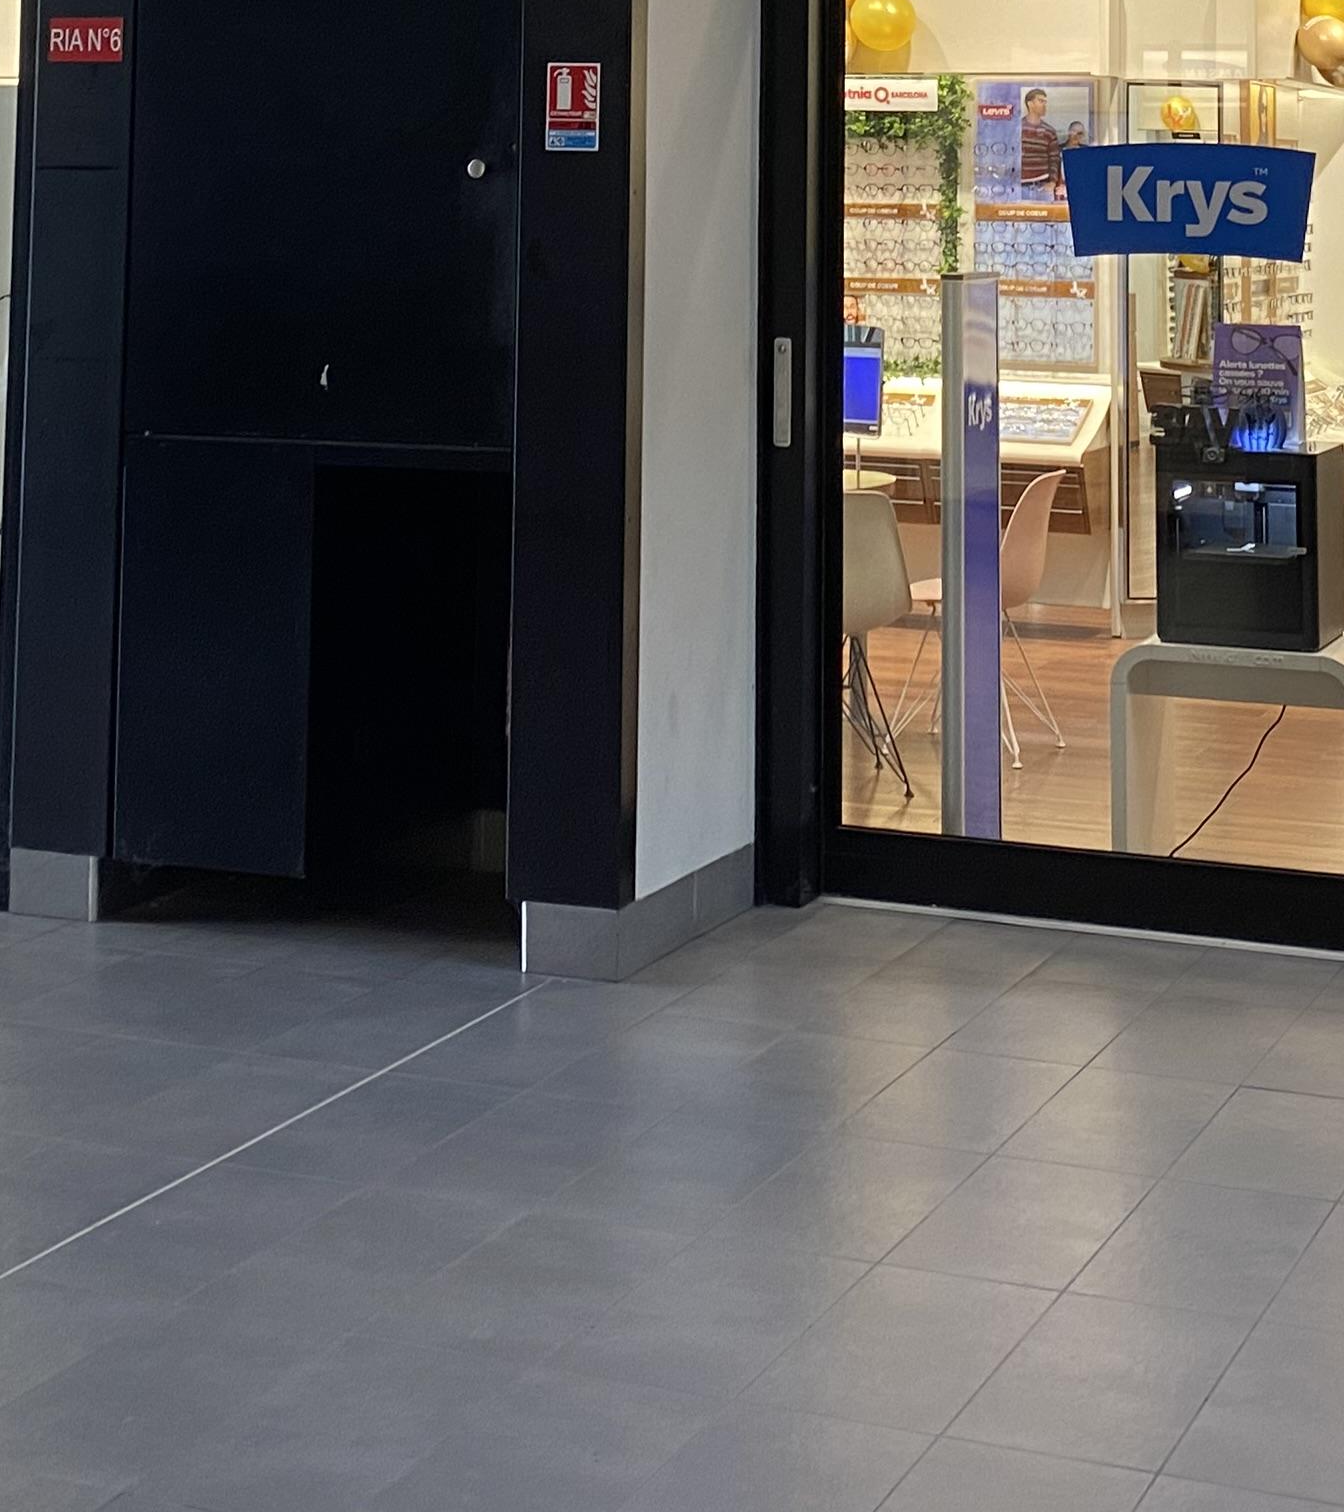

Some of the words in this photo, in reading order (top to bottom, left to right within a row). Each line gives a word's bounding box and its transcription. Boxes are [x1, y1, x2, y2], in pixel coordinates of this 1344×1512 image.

[49, 28, 84, 52] RIA
[87, 27, 121, 52] N°6
[1107, 165, 1268, 237] Krys
[1219, 360, 1247, 370] Alerte
[1218, 376, 1233, 386] On
[1234, 377, 1256, 387] vous
[968, 391, 993, 431] Krys
